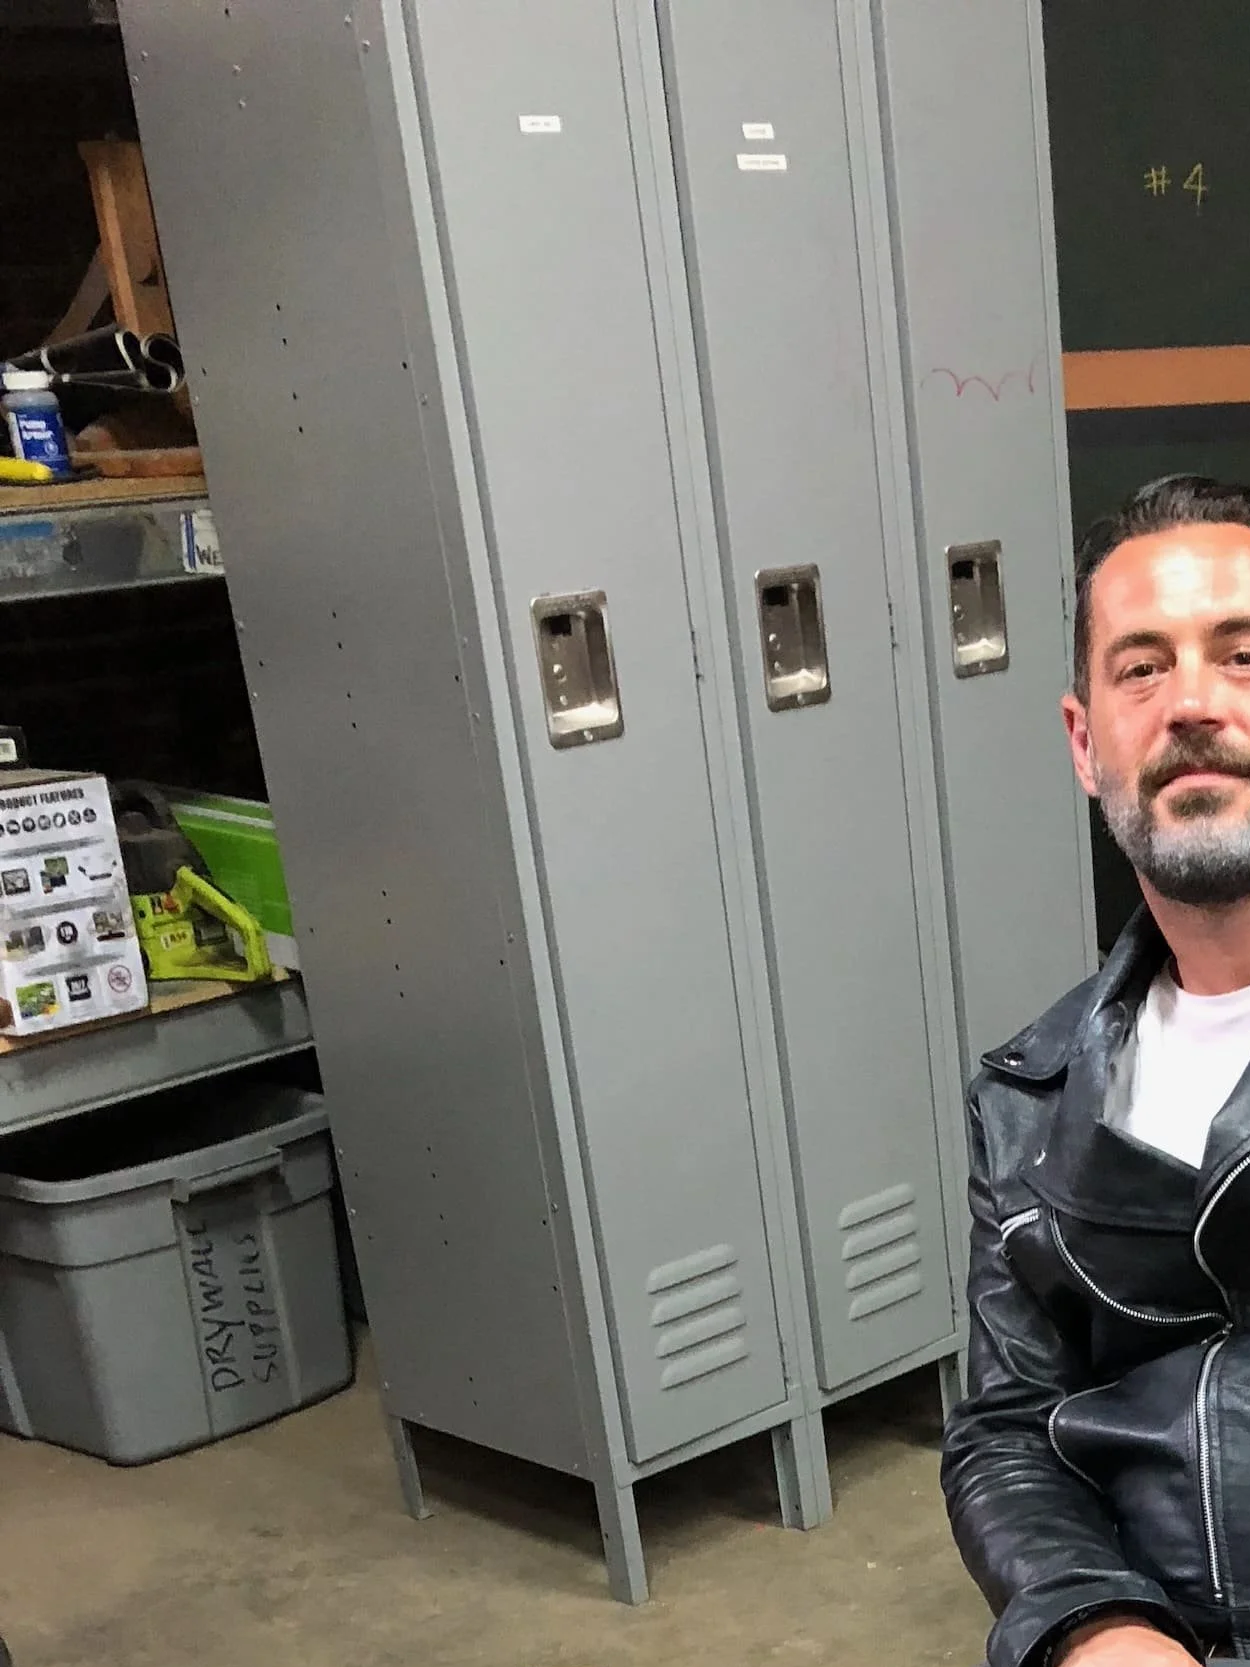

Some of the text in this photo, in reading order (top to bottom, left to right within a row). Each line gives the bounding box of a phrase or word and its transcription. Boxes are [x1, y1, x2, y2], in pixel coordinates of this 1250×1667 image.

[1143, 163, 1208, 214] #4
[0, 794, 37, 811] RODUCT
[186, 1223, 246, 1392] DRYWALL
